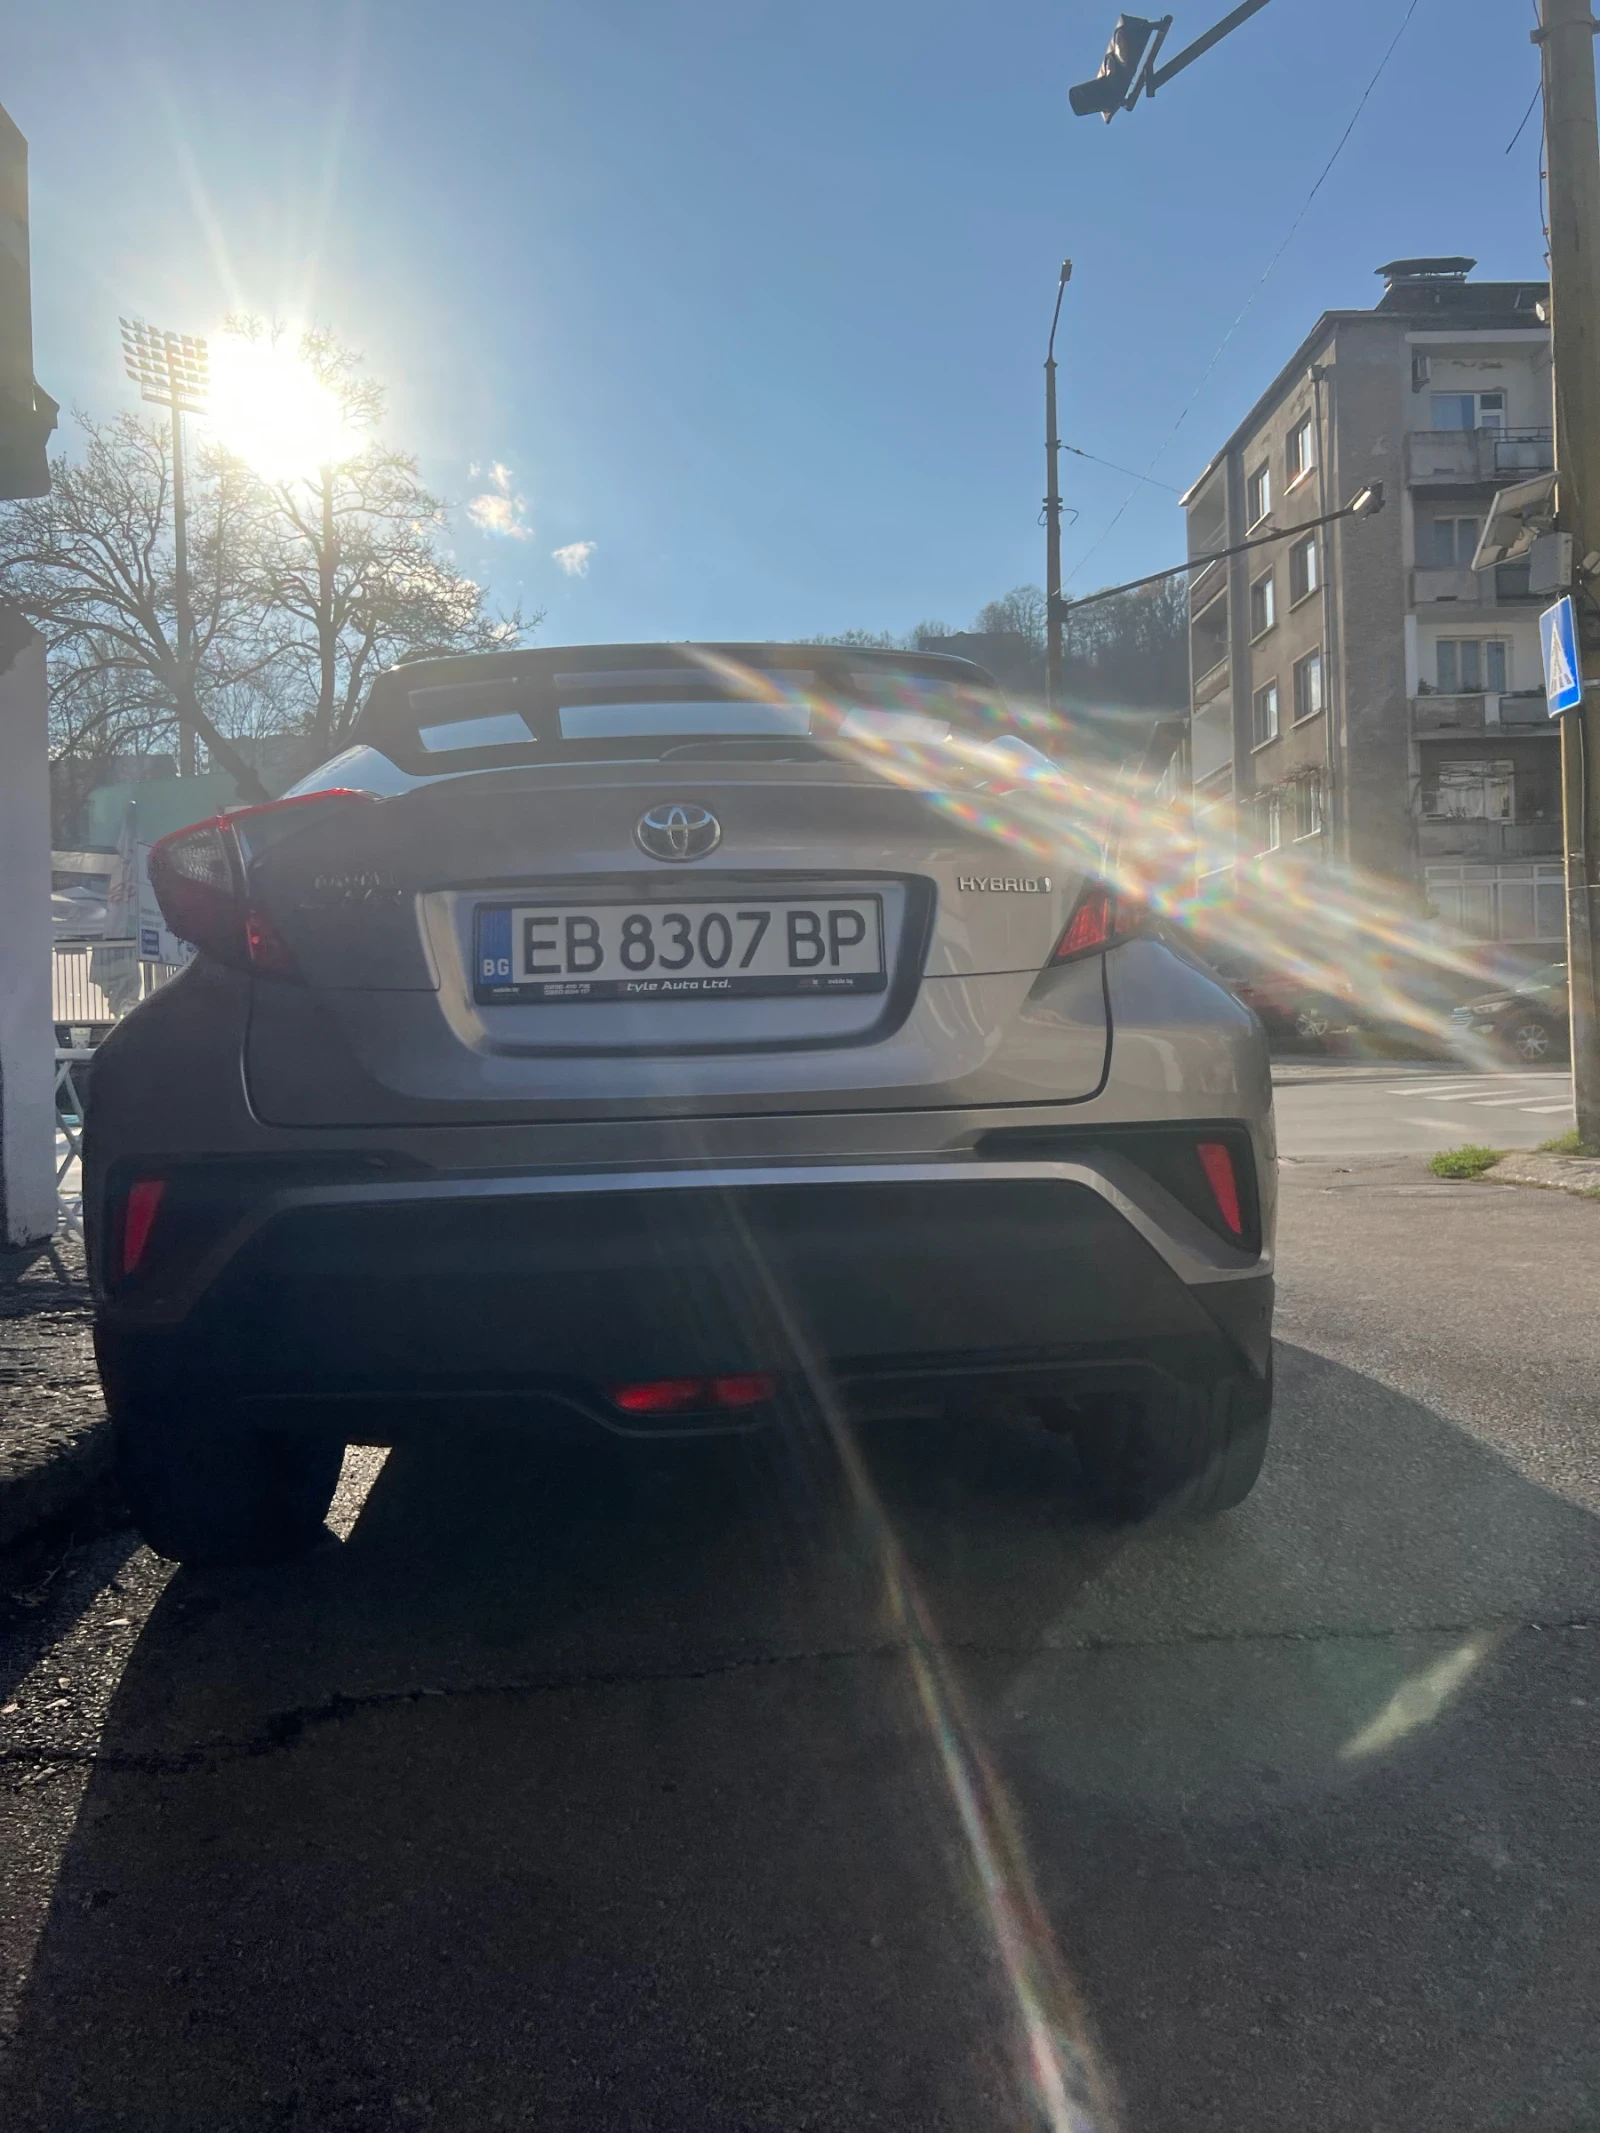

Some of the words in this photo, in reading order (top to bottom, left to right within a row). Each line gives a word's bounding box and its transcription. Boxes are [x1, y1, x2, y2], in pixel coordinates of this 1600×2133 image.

[958, 876, 1039, 892] HYBRID
[523, 916, 603, 975] EB
[620, 911, 771, 971] 8307
[788, 910, 866, 967] BP
[483, 959, 510, 976] BG
[661, 980, 700, 991] Auto
[703, 979, 732, 989] Ltd.
